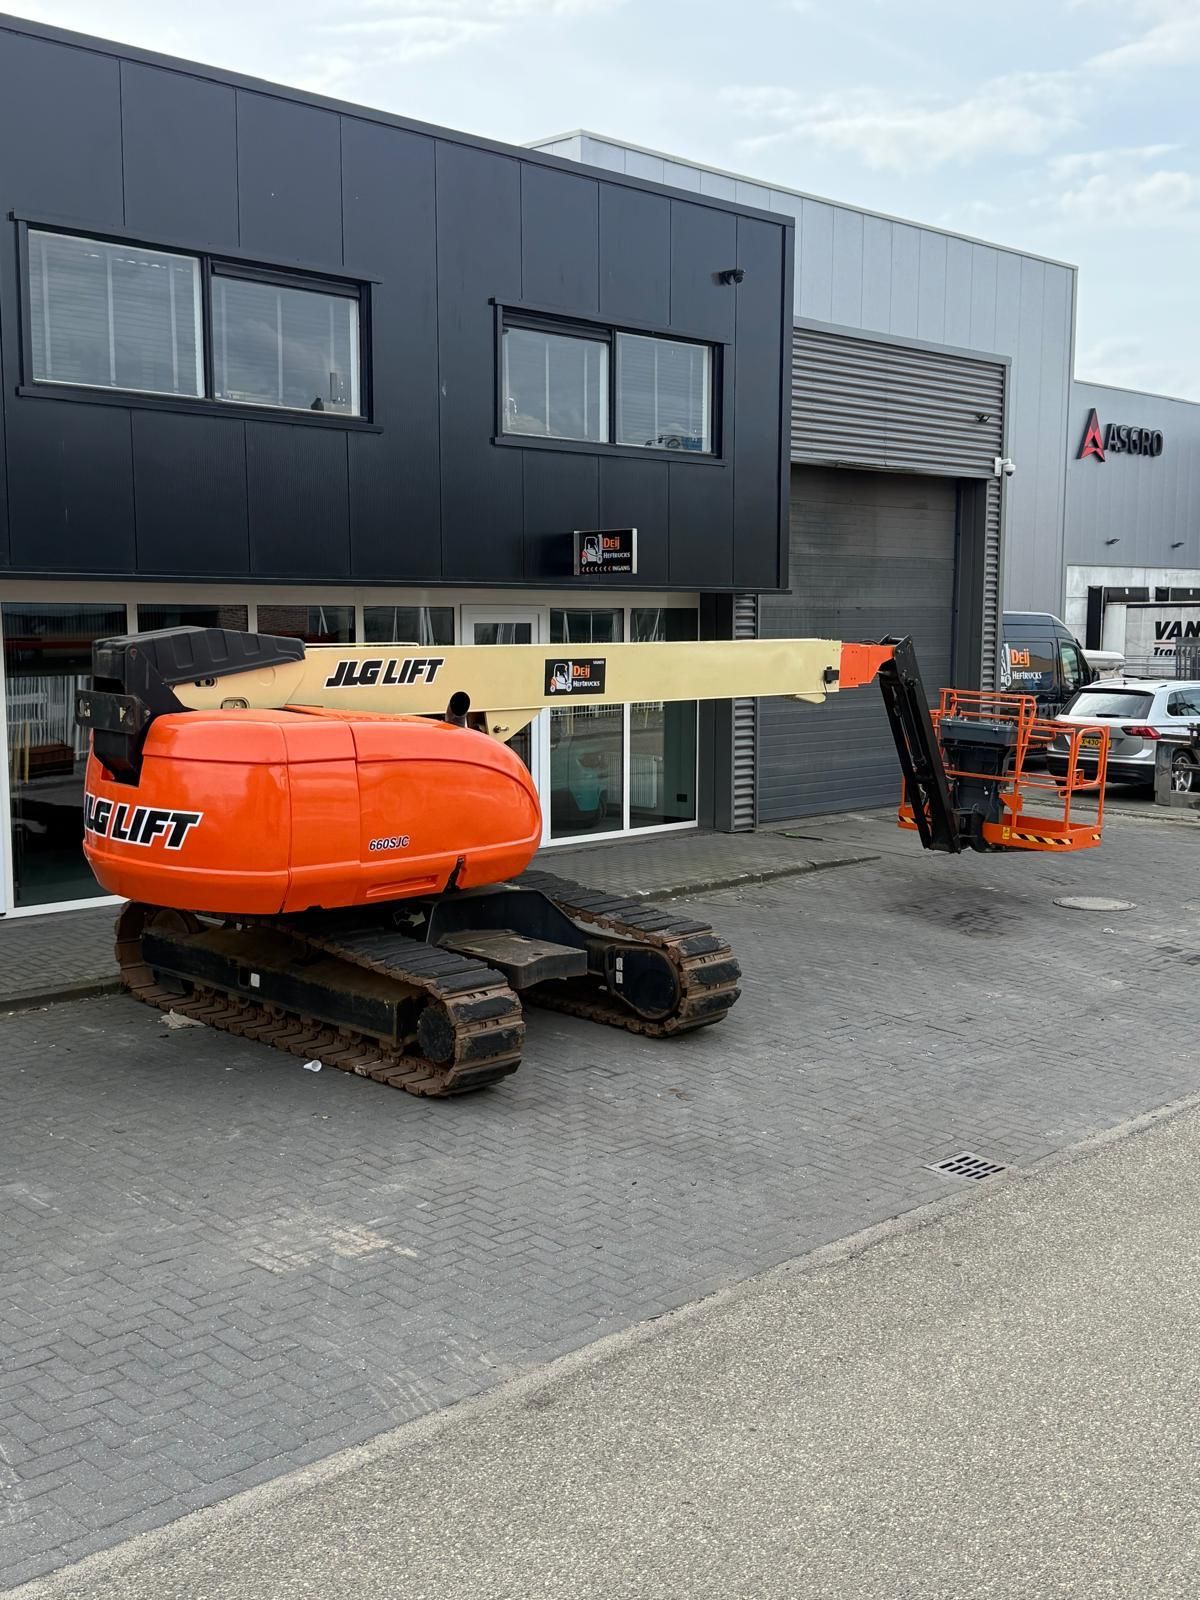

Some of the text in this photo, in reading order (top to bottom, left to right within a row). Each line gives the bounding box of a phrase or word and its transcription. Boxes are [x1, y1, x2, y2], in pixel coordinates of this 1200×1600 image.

[1104, 423, 1163, 457] ASGRO
[324, 657, 445, 688] JLG LIFT
[110, 802, 204, 850] LIFT
[368, 835, 410, 851] 660SJC
